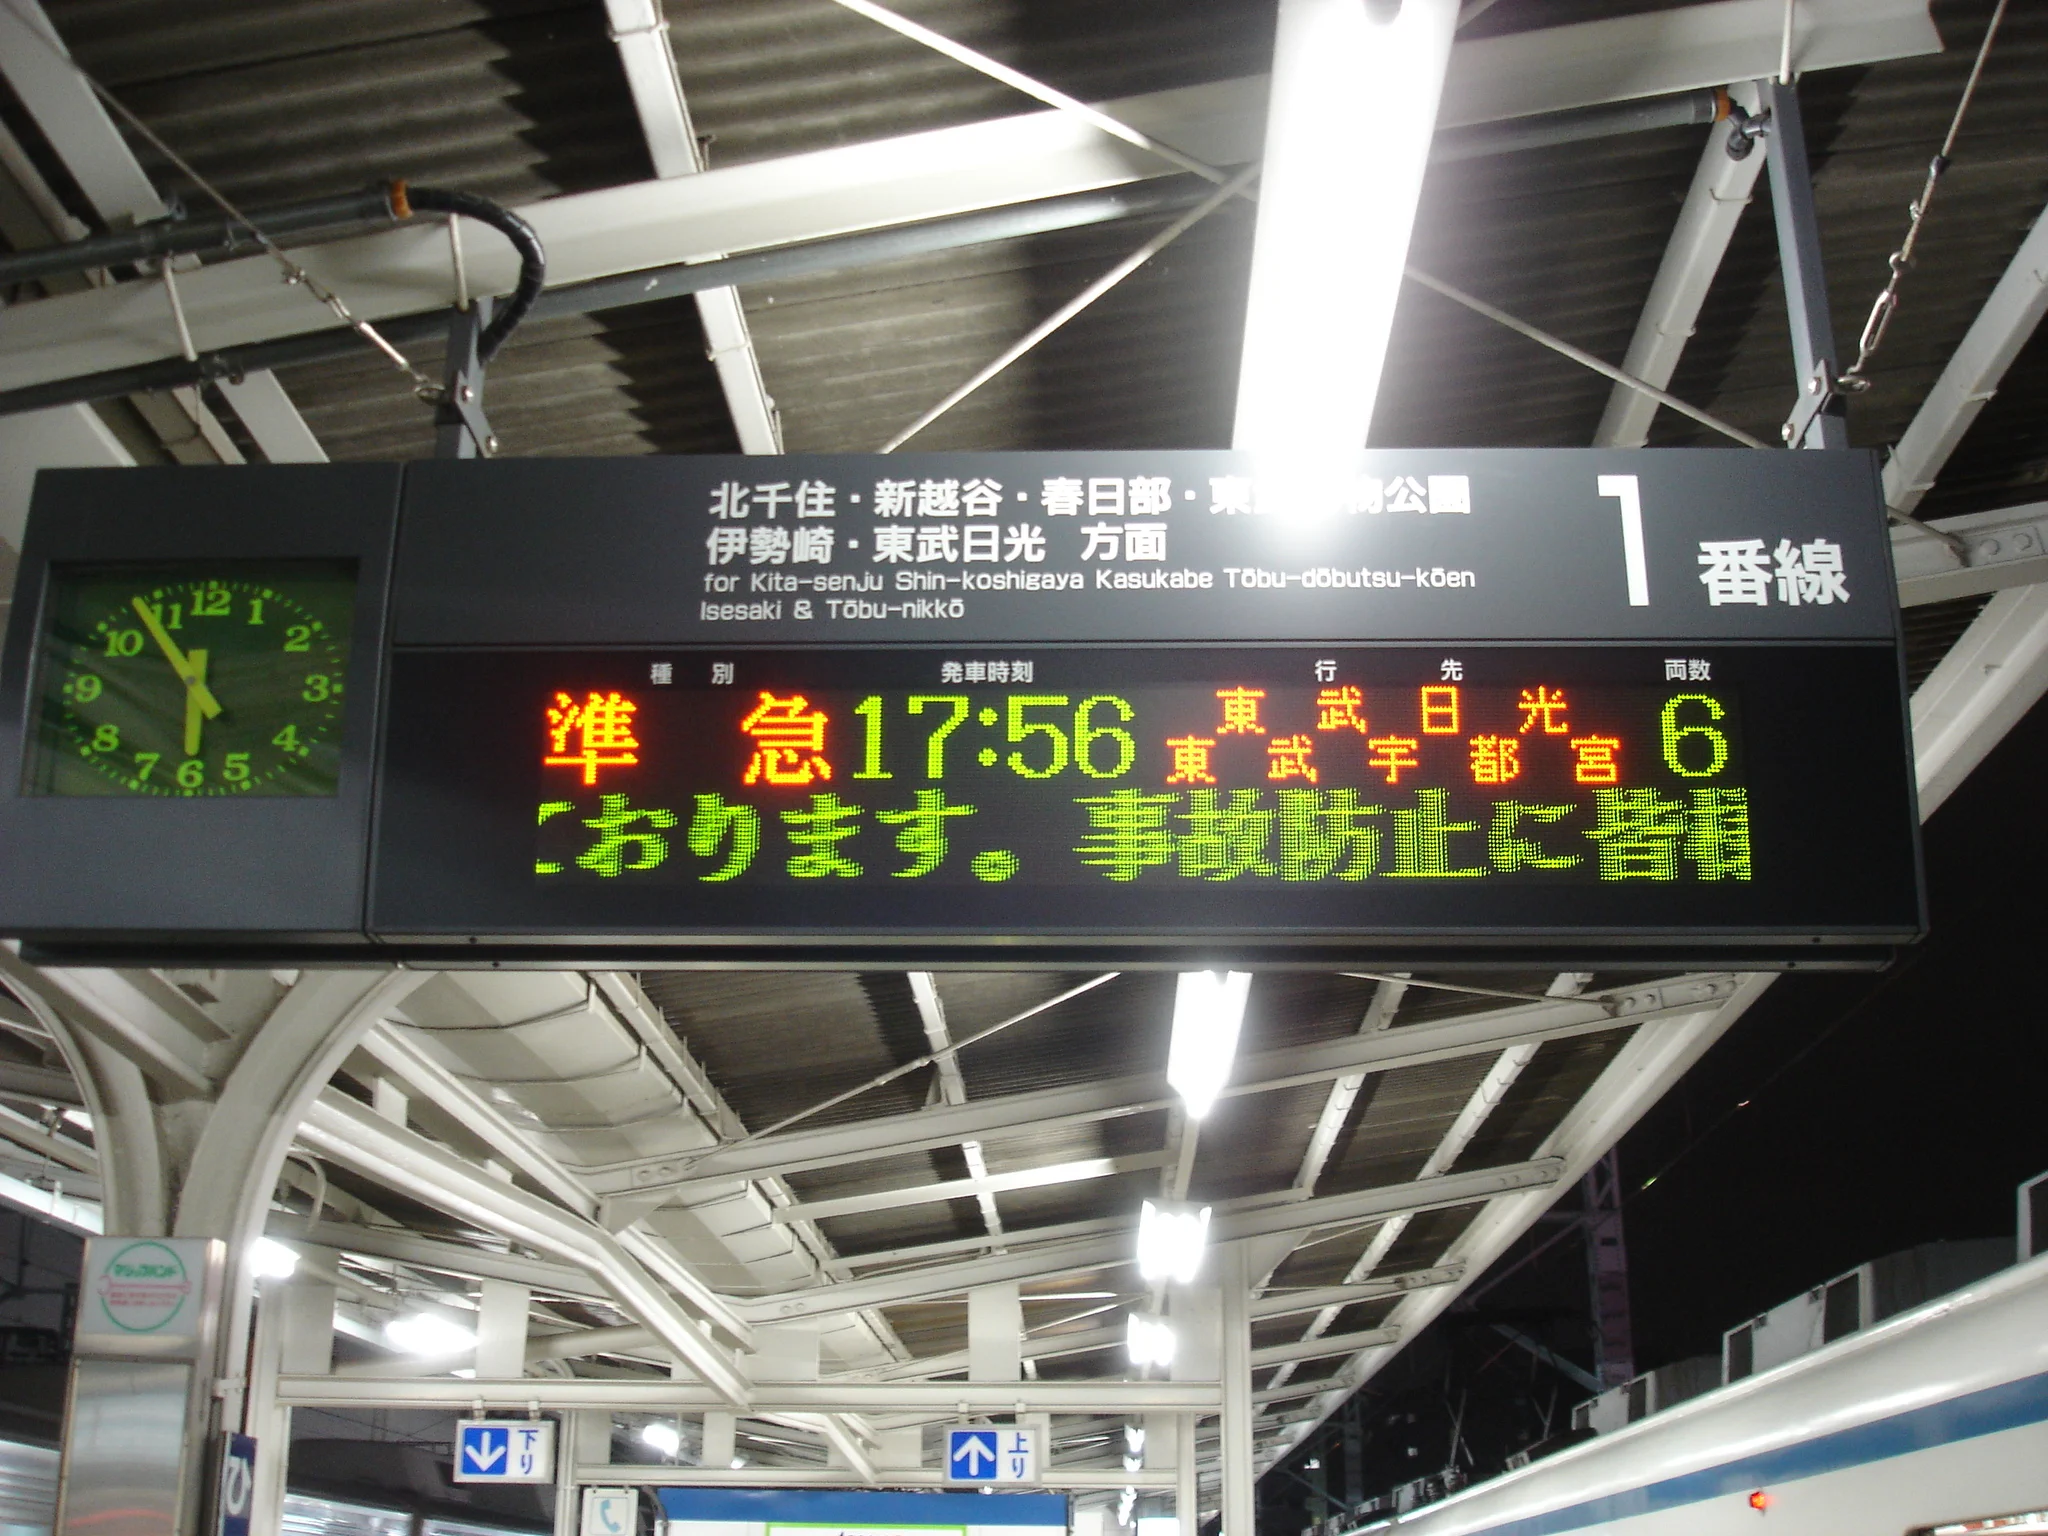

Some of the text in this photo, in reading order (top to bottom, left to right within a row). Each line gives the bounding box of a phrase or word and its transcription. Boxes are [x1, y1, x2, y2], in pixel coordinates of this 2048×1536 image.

[1080, 521, 1168, 563] 方面
[1597, 472, 1851, 607] 1 番線
[704, 573, 740, 592] for
[751, 571, 884, 592] Kita-senju
[895, 570, 1085, 594] Shin-koshigaya
[1096, 569, 1213, 590] Kasukabe
[190, 590, 231, 615] 12
[248, 599, 264, 624] 1
[701, 597, 965, 621] Isesaki & Tōbu-nikkō
[104, 630, 144, 657] 10
[283, 626, 311, 651] 2
[941, 660, 1034, 684] 発車時刻
[1664, 658, 1711, 681] 両数
[75, 675, 102, 701] 9
[303, 674, 329, 701] 3
[92, 725, 119, 751] 8
[272, 725, 300, 751] 4
[854, 695, 1135, 779] 17:56
[1661, 693, 1727, 778] 6
[134, 753, 160, 781] 7
[177, 760, 204, 787] 6
[223, 753, 249, 781] 5
[518, 1429, 539, 1475] 下り
[1008, 1431, 1029, 1478] 上り
